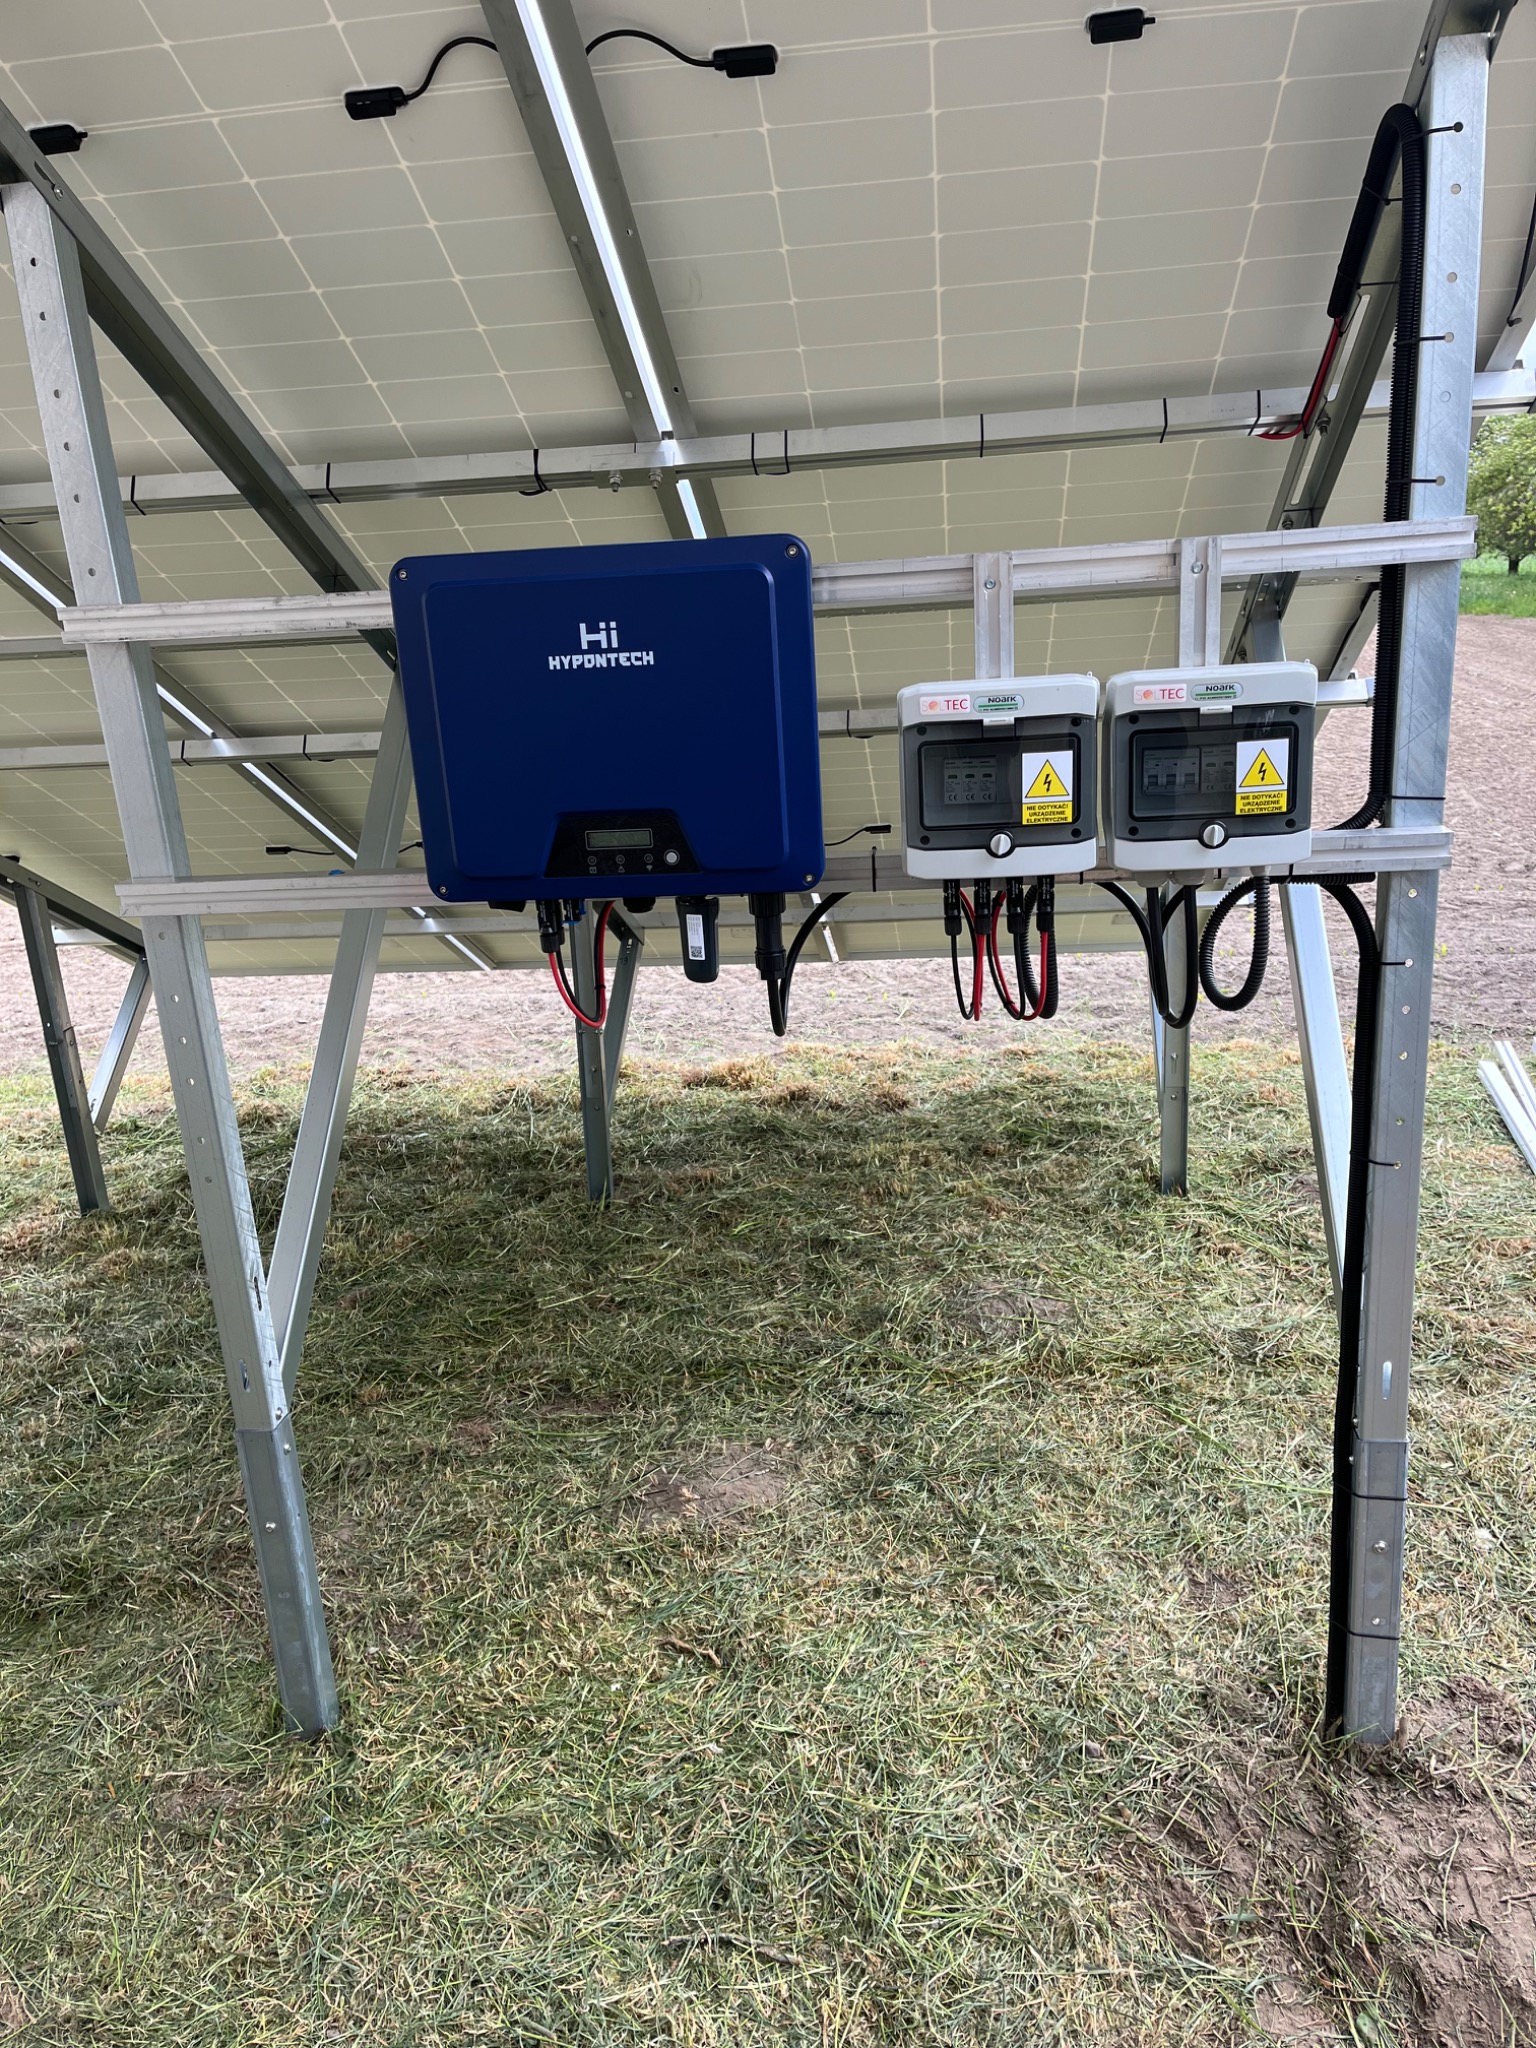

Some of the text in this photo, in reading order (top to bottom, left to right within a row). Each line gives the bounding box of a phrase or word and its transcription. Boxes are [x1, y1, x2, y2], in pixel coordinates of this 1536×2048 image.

[579, 621, 619, 650] Hi
[548, 651, 655, 670] HYPONTECH
[1239, 806, 1283, 814] ELEKTRYCZNE
[1026, 816, 1069, 824] ELEKTRYCZNE
